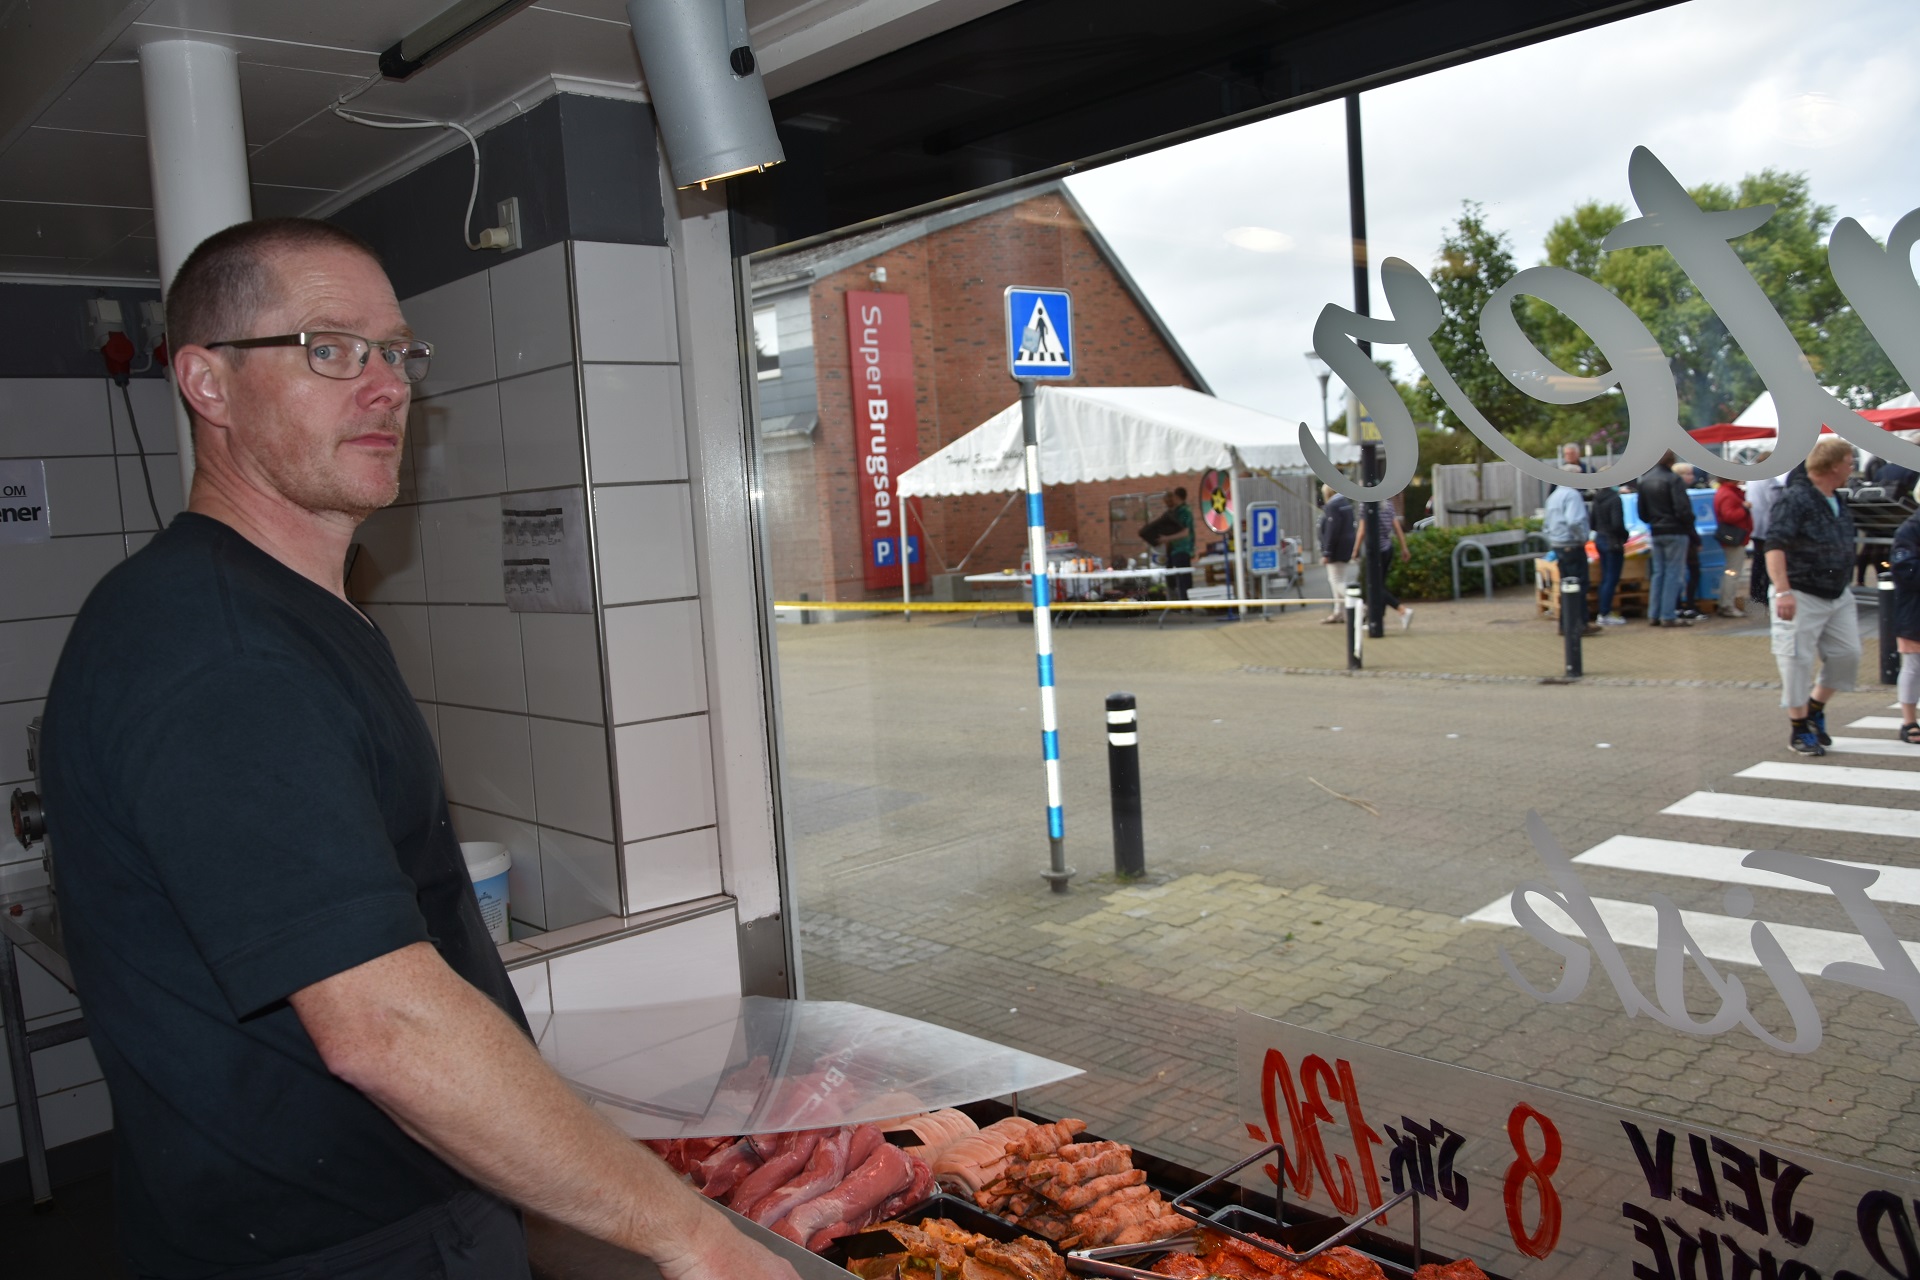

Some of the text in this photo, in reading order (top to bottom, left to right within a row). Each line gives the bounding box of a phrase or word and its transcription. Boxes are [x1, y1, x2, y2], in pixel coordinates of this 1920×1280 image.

[860, 305, 892, 528] SuperBrugsen
[3, 485, 26, 496] OM
[1257, 511, 1274, 544] P
[877, 541, 890, 563] P
